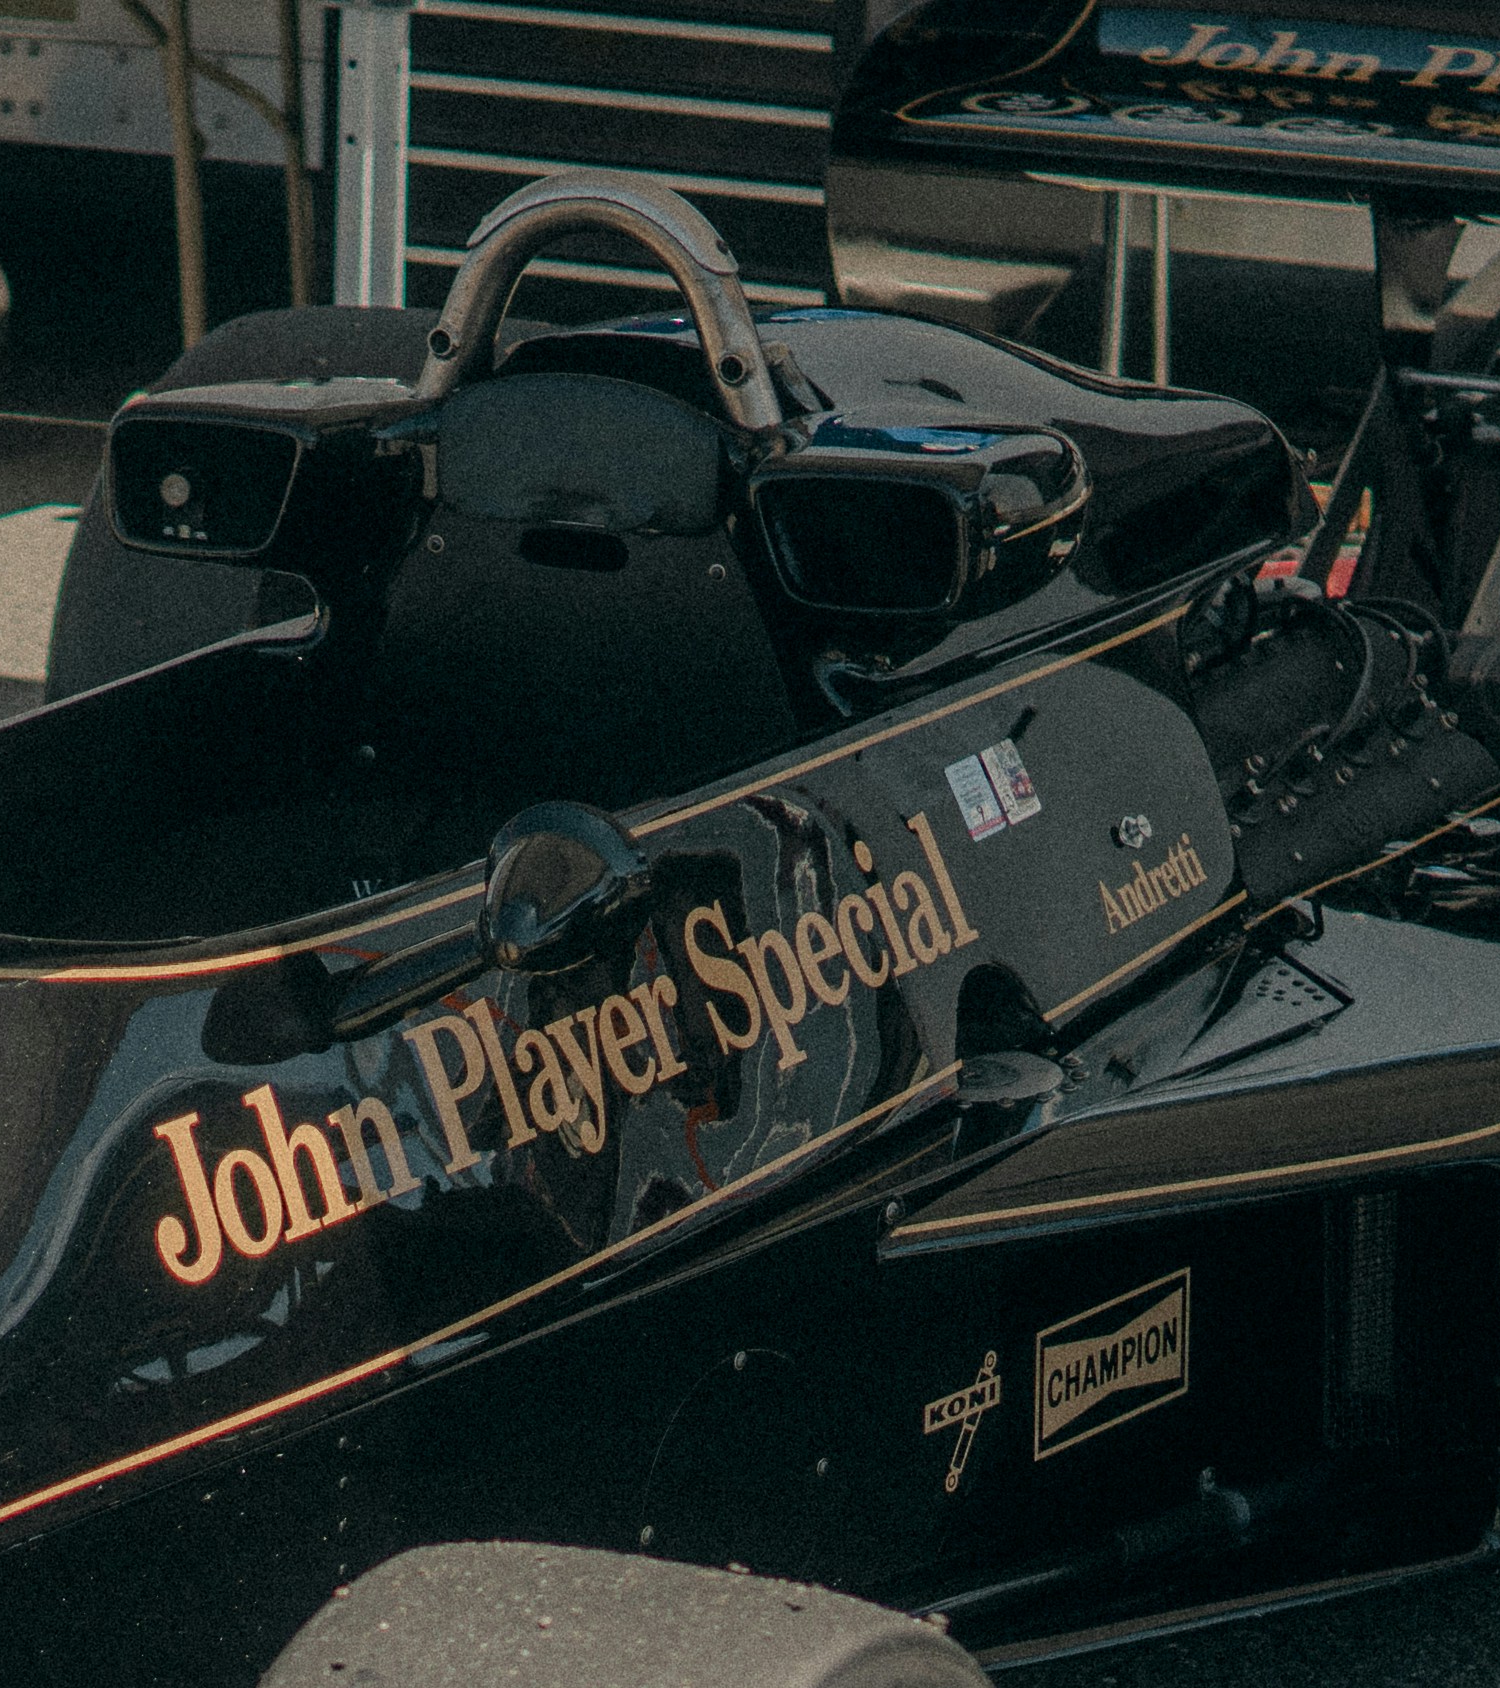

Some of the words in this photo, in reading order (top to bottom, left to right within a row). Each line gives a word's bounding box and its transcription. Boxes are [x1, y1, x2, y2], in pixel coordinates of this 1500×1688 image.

[1140, 23, 1382, 82] John
[1099, 833, 1209, 934] Andretti
[153, 1083, 422, 1286] John
[402, 973, 688, 1176] Player
[683, 813, 979, 1071] Special
[927, 1380, 998, 1426] KONI
[1046, 1317, 1178, 1410] CHAMPION
